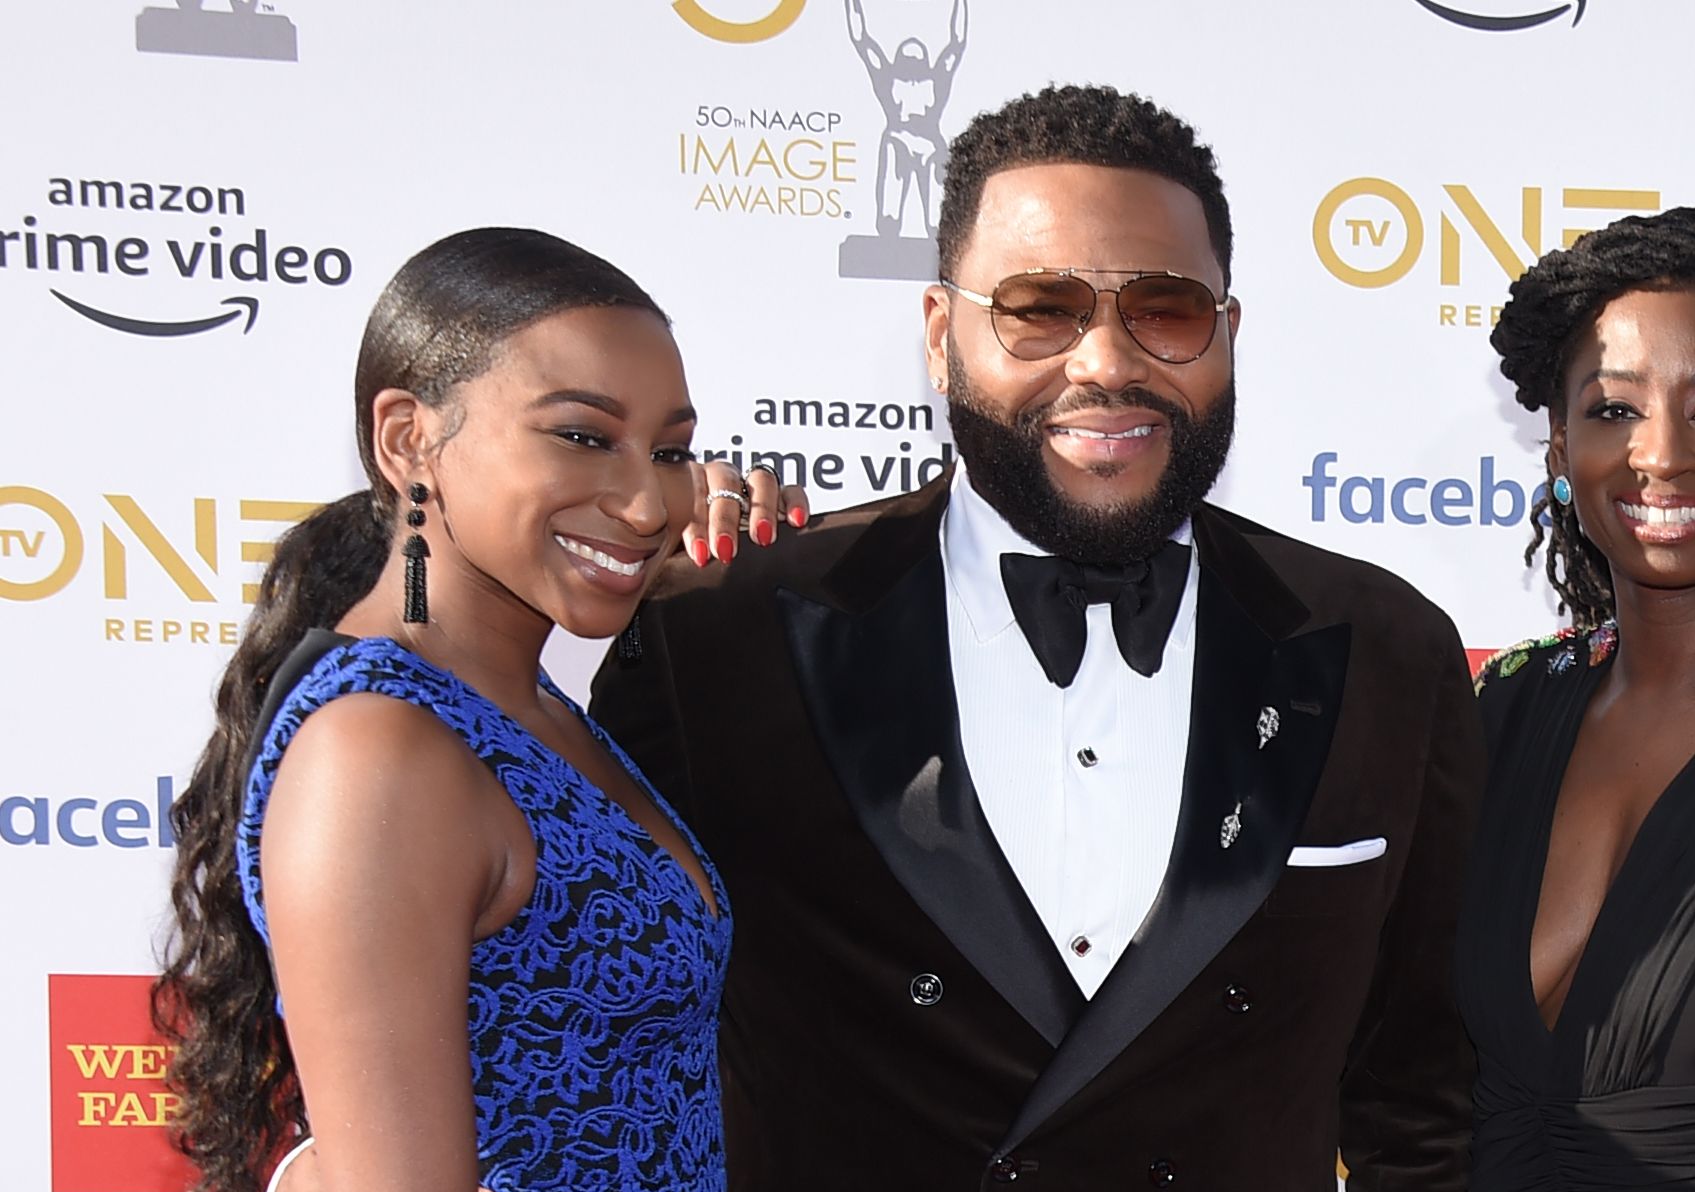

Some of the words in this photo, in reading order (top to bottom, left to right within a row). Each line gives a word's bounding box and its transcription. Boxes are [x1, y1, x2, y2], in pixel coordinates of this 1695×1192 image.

[749, 108, 842, 133] NAACP
[679, 133, 857, 183] IMAGE
[48, 177, 246, 216] amazon
[1345, 218, 1391, 247] TV
[166, 226, 352, 287] video
[754, 398, 933, 431] amazon
[66, 1044, 182, 1080] WE
